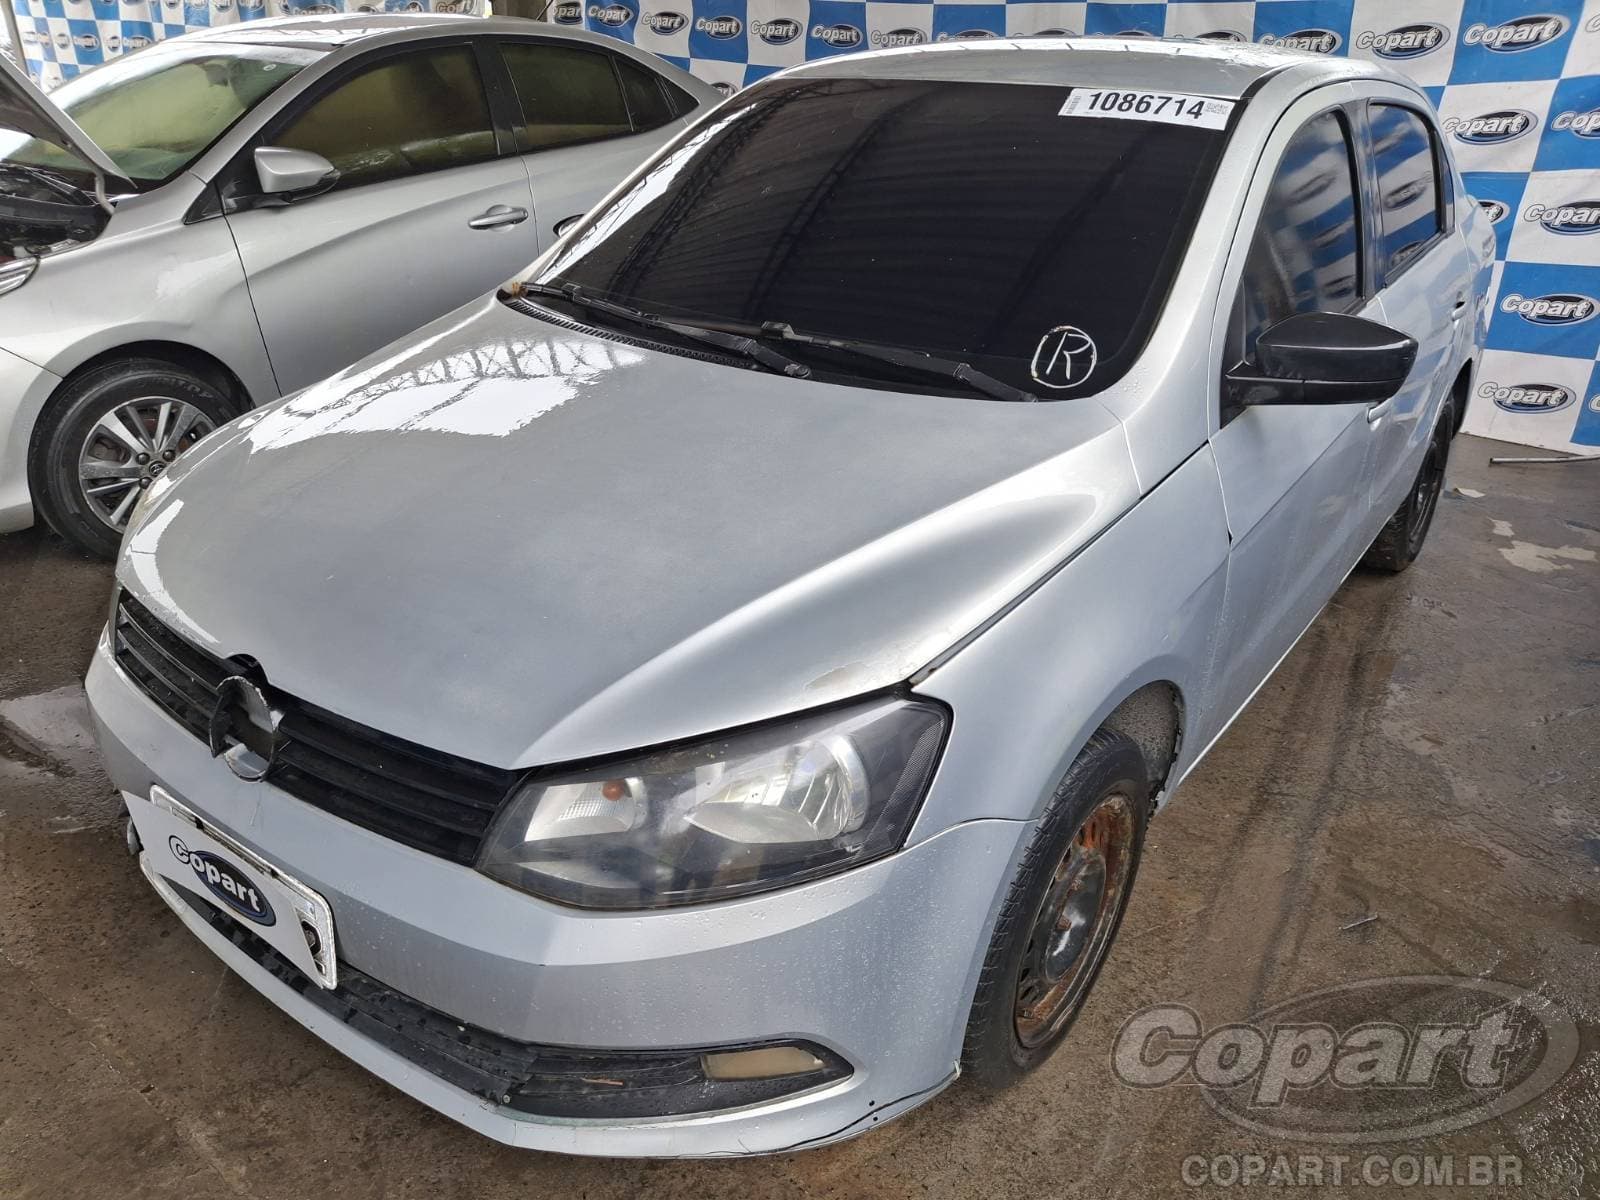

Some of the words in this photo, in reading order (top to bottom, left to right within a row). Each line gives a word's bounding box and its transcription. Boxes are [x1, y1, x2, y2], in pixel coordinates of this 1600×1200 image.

[642, 12, 681, 29] Copart
[695, 17, 737, 35] Copart
[751, 20, 796, 38] Copart
[1464, 15, 1559, 45] Copart
[812, 25, 858, 43] Copart
[871, 30, 920, 47] Copart
[1356, 26, 1440, 50] Copart
[1089, 91, 1206, 120] 1086714
[1442, 112, 1529, 139] Copart
[1501, 294, 1592, 319] Copart
[1478, 381, 1566, 407] Copart
[168, 834, 263, 915] Copart
